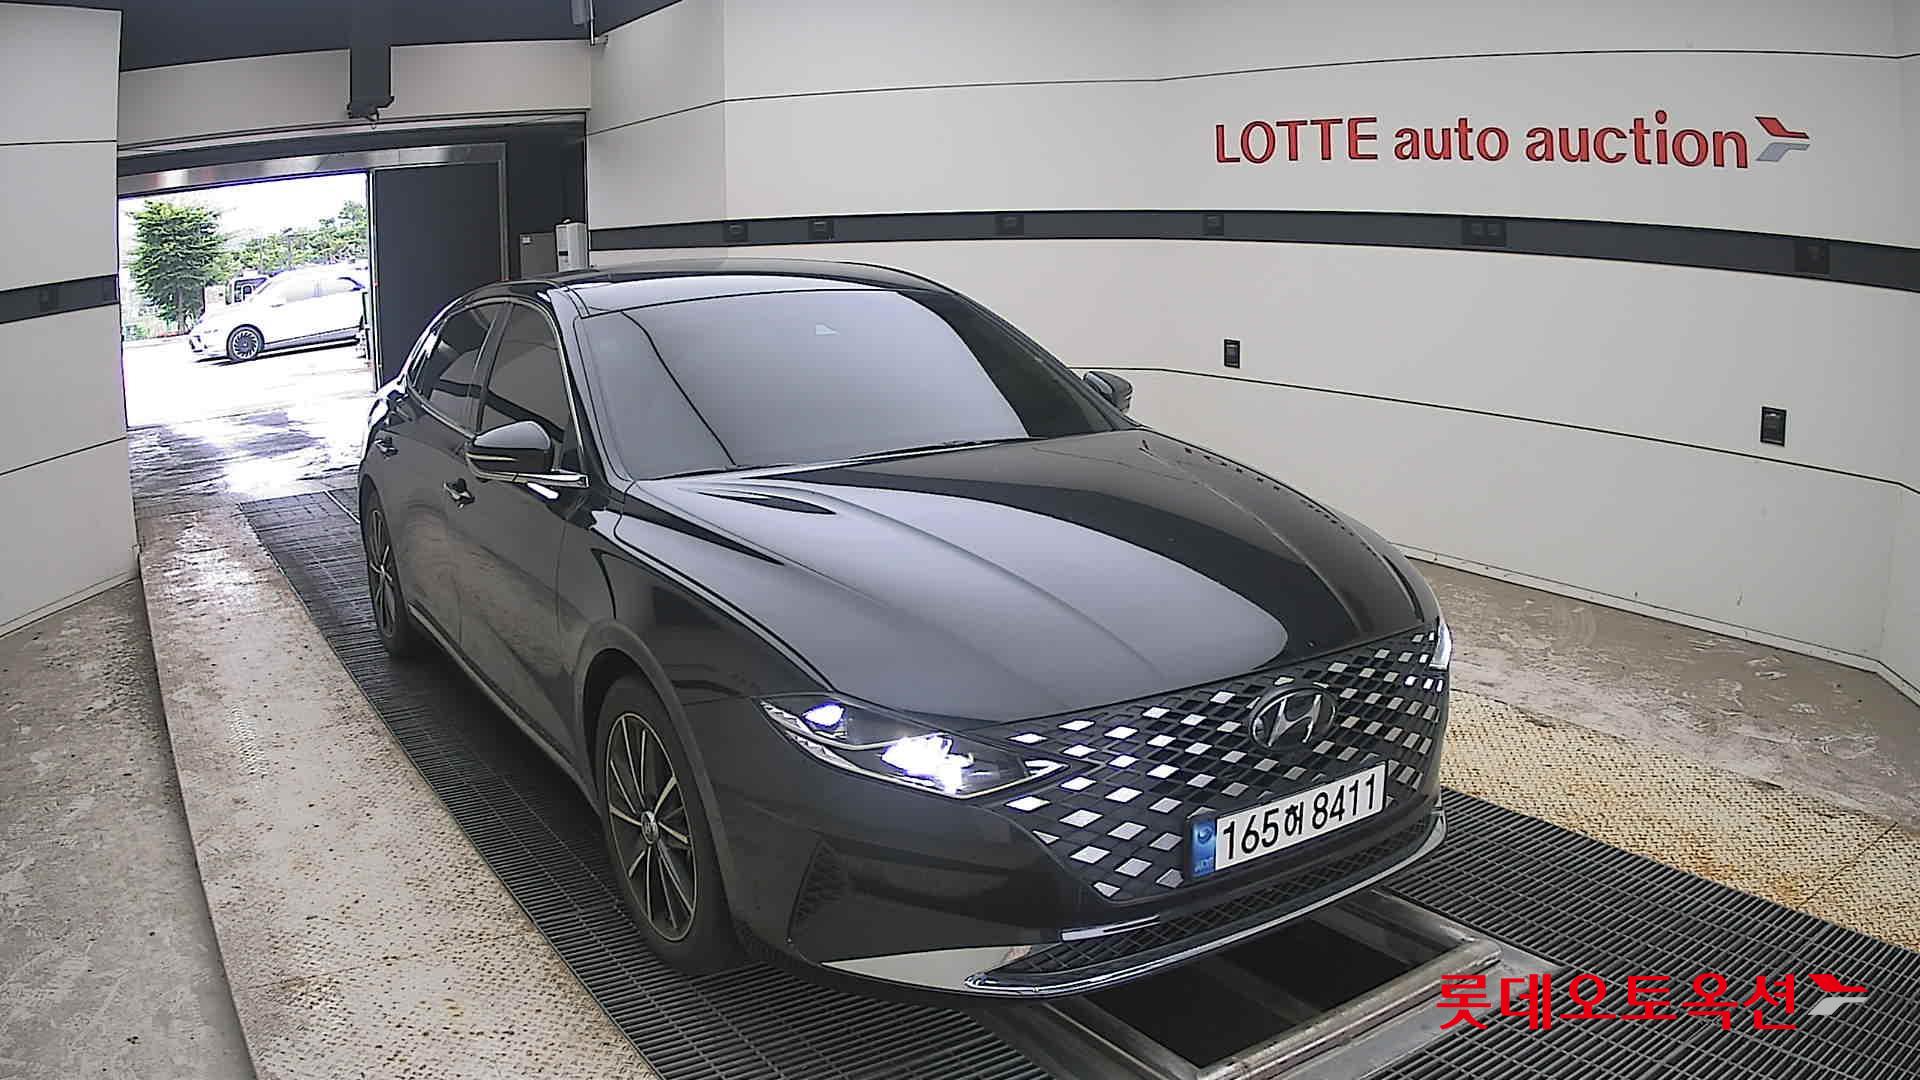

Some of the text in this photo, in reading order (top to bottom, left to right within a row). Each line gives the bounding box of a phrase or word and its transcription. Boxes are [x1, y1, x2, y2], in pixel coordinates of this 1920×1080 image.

[1215, 109, 1750, 170] LOTTE auto auction
[1223, 773, 1376, 860] 165허 8411
